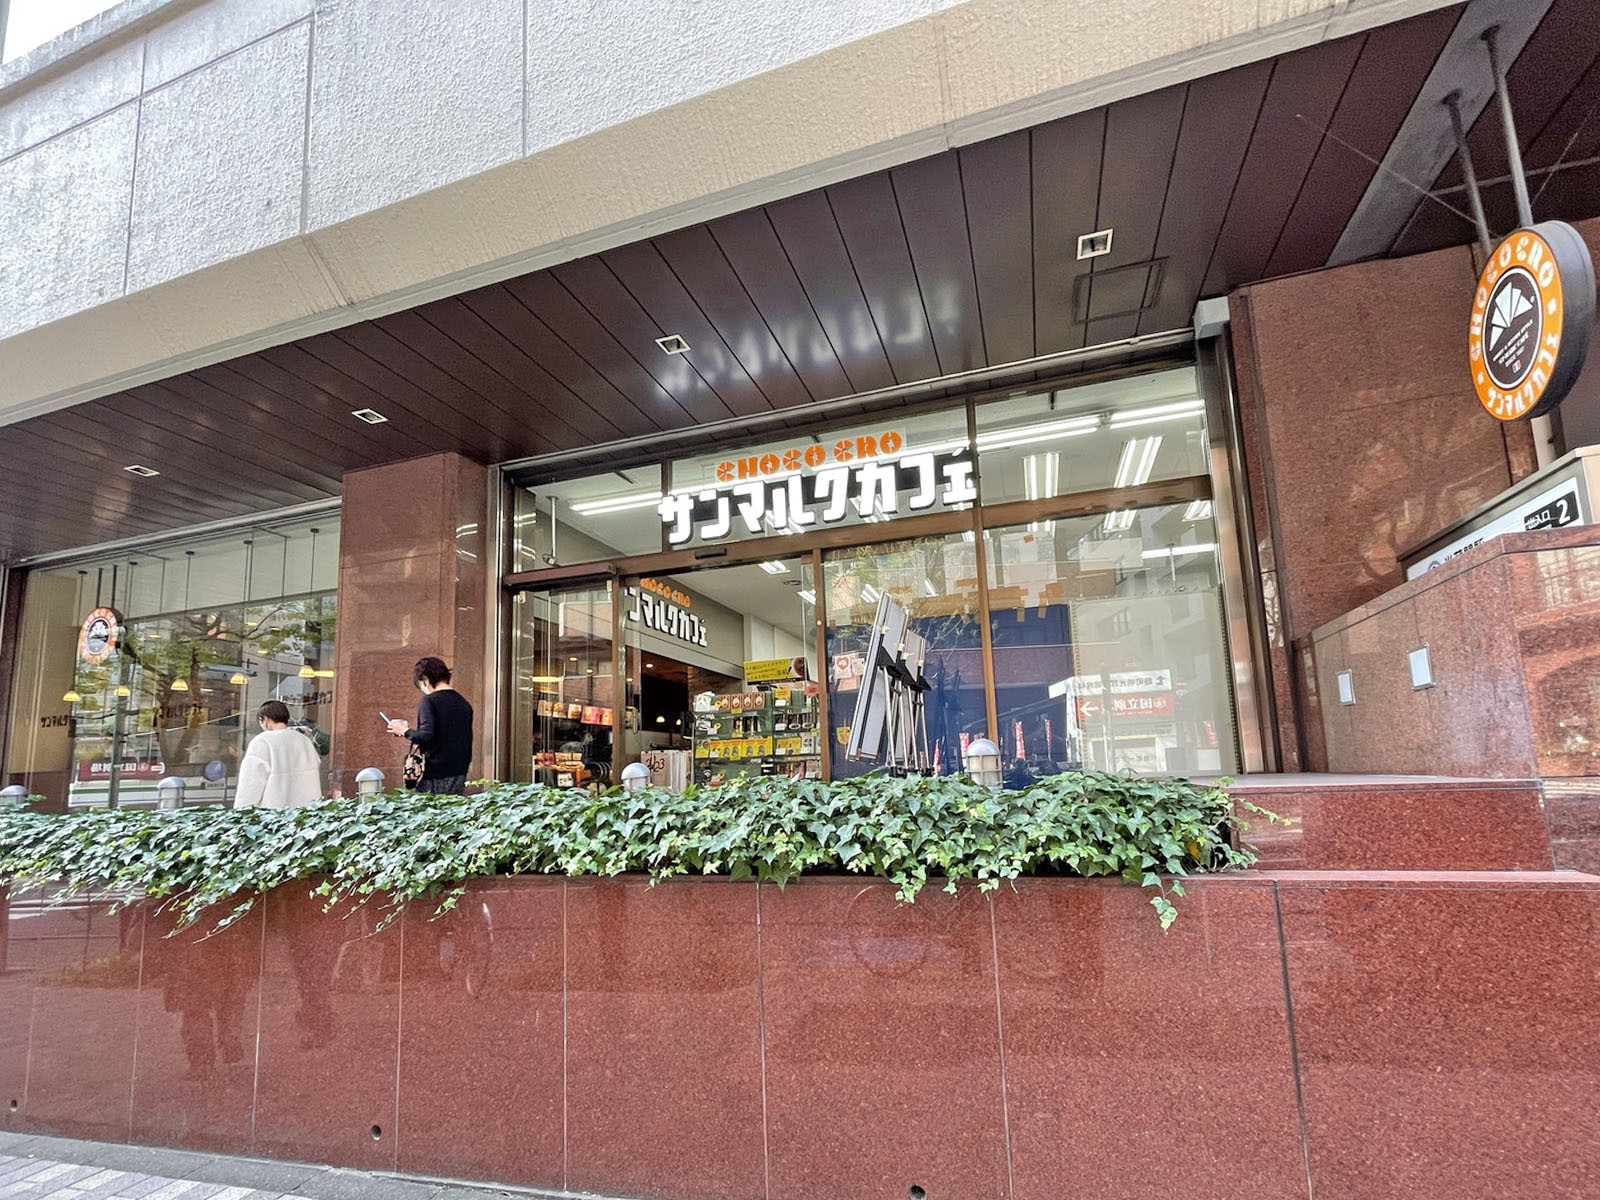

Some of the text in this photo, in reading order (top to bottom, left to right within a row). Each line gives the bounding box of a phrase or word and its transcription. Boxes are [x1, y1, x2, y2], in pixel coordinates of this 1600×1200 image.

[1470, 243, 1512, 362] CHOCO
[1516, 236, 1555, 288] CRO
[1487, 333, 1559, 416] サンマルクカフェ
[716, 431, 902, 482] CHOCO CRO
[657, 443, 977, 545] サンマルクカフェ
[1556, 499, 1571, 525] 2
[624, 587, 708, 647] ンマルクカフェ
